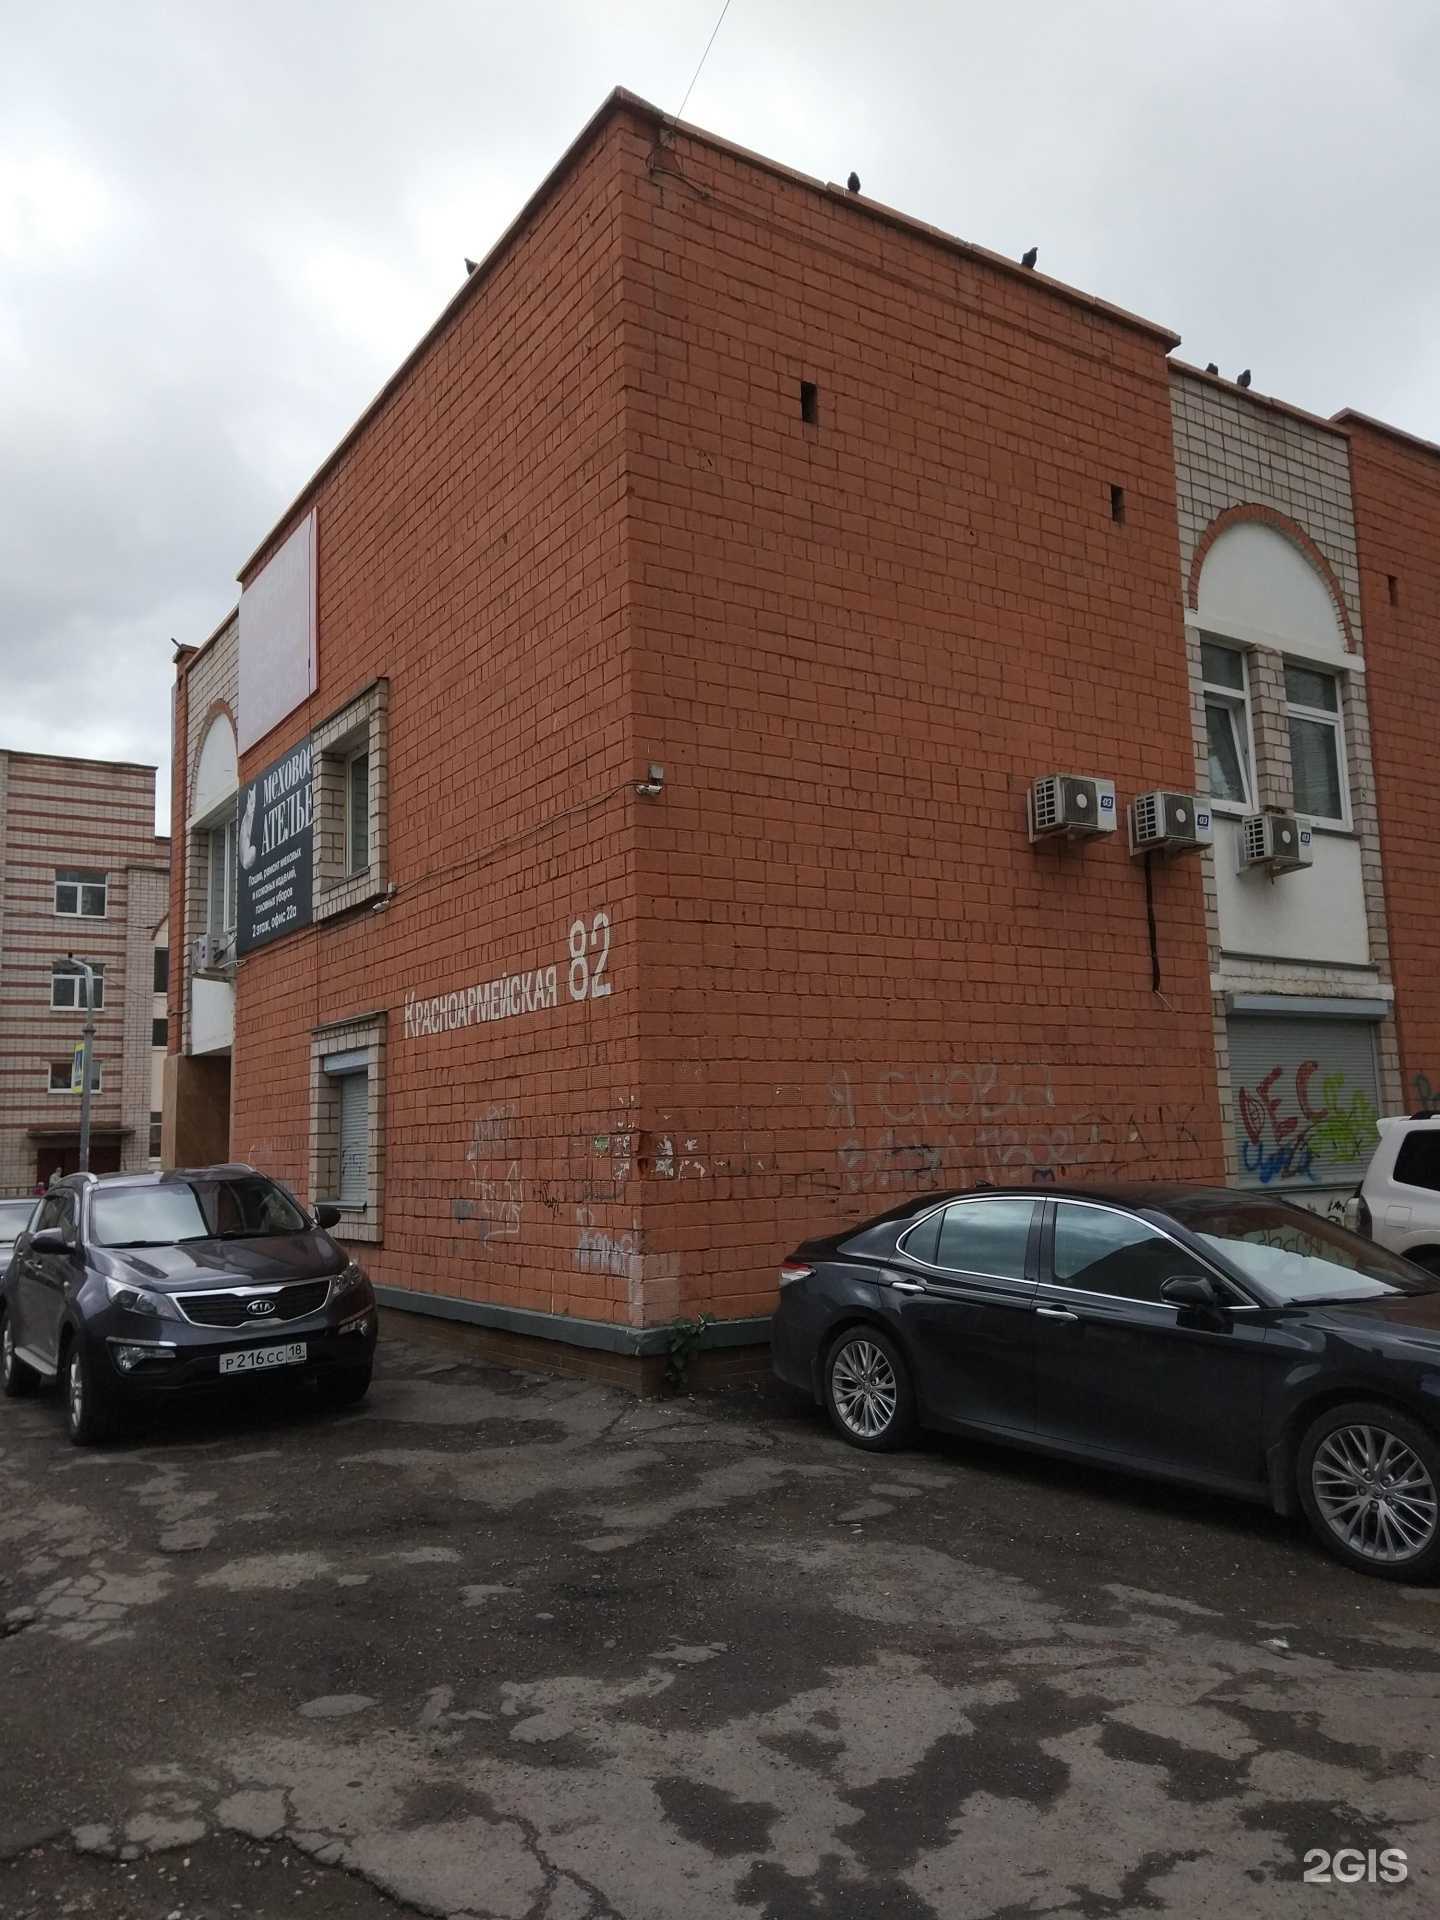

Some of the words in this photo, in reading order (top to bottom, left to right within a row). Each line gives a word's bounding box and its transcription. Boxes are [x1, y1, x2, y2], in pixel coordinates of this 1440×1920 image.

[261, 781, 314, 856] АТЕЛЬЕ
[252, 924, 256, 938] 2
[271, 912, 286, 928] офис
[404, 965, 557, 1040] КРАСНОАРМЕЙСКАЯ
[568, 912, 612, 1001] 82
[251, 1303, 271, 1312] KIA
